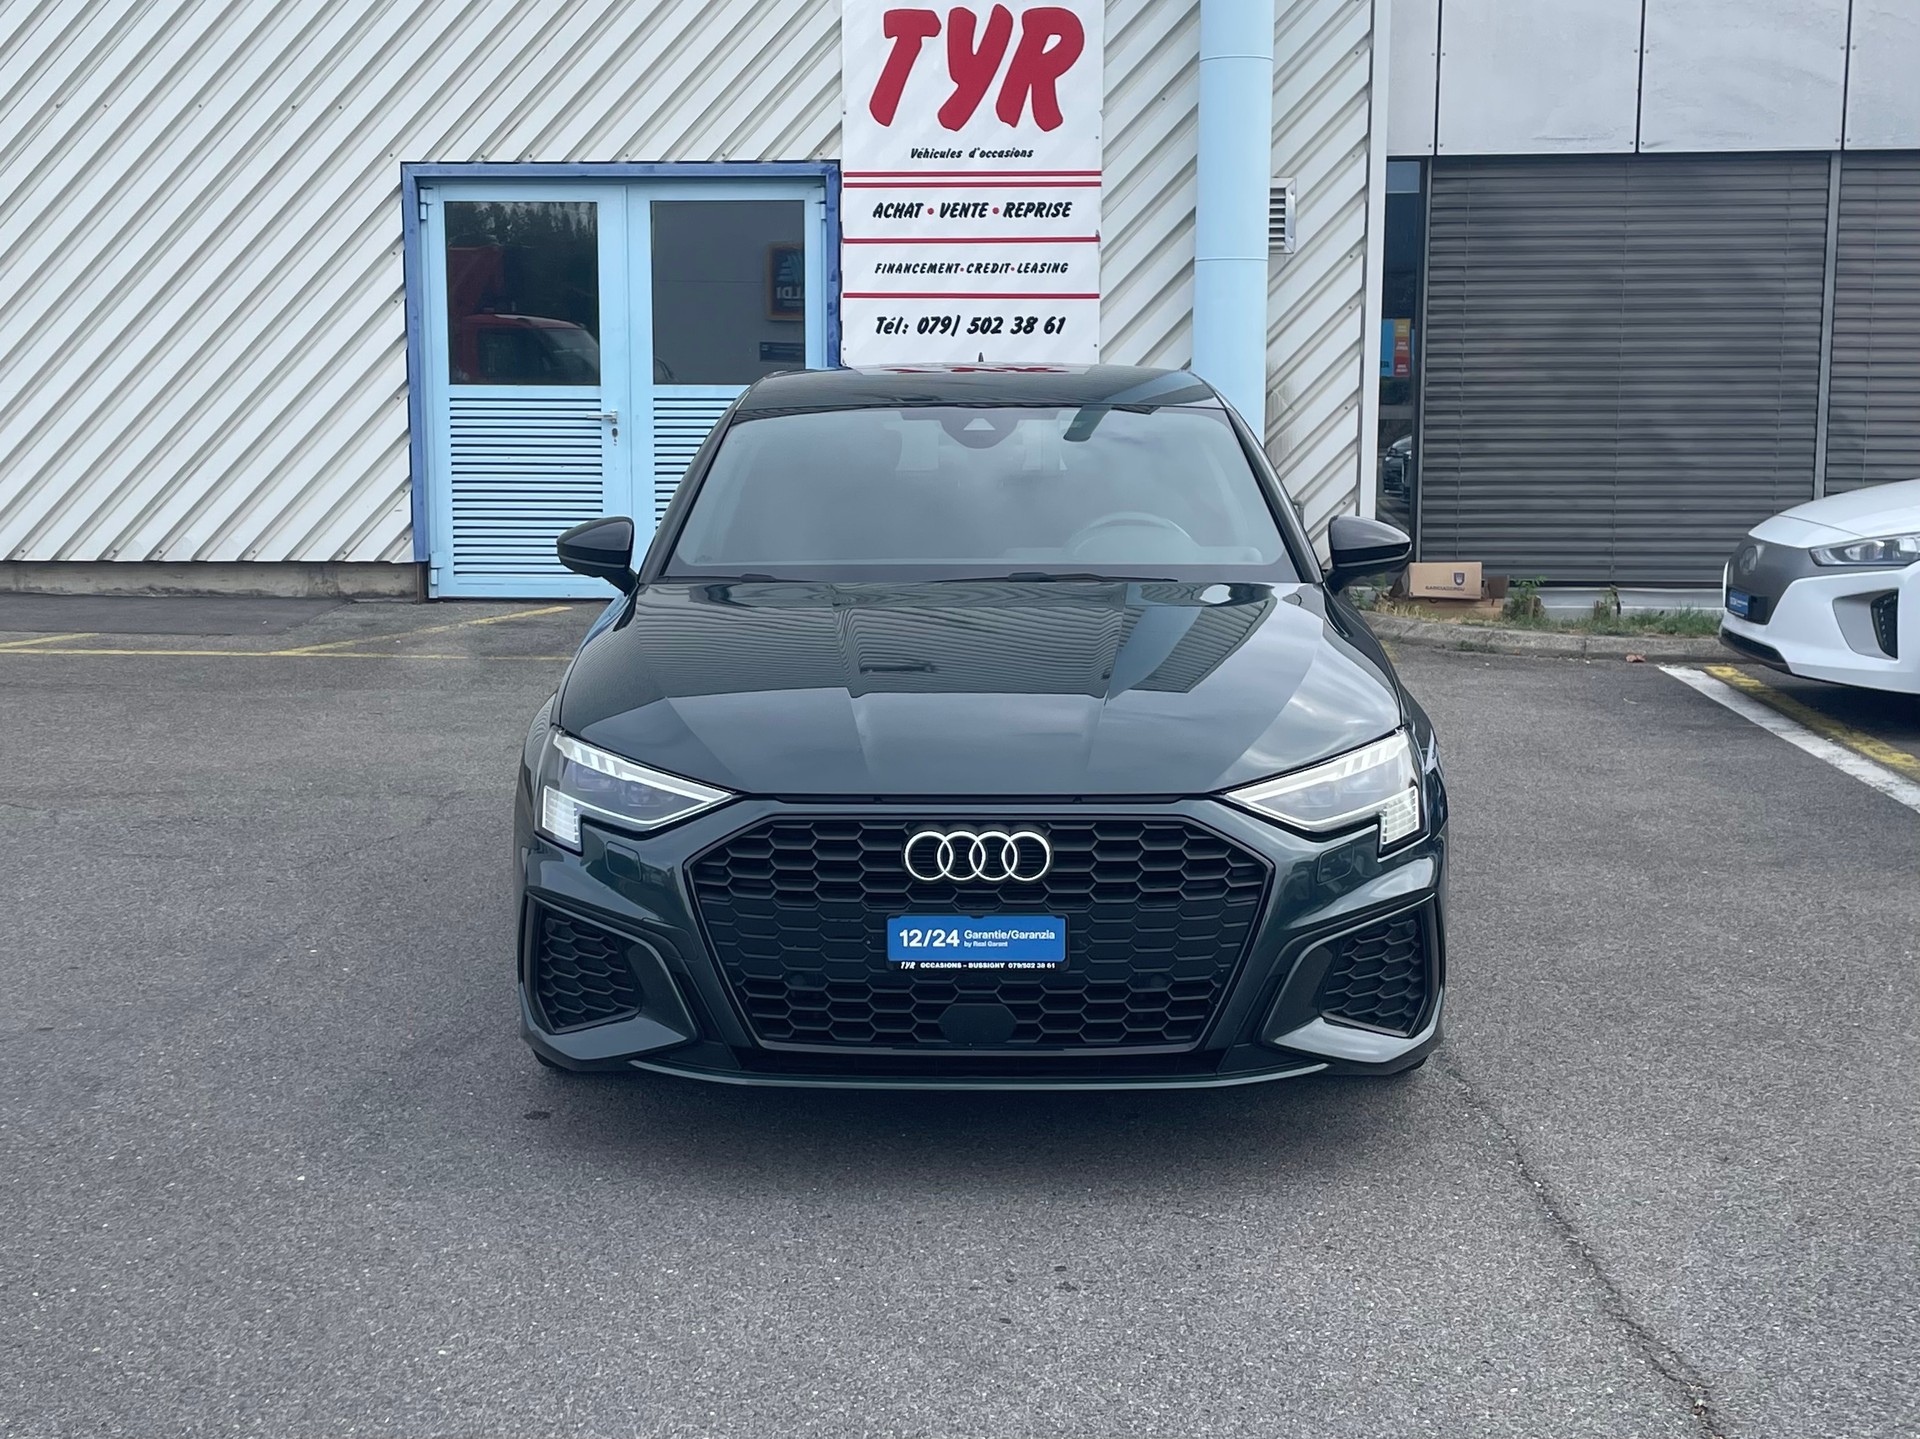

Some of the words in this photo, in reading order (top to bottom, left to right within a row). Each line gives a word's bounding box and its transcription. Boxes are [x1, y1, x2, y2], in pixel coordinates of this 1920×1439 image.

[869, 3, 1085, 132] TYR
[910, 147, 963, 159] Véhicules
[968, 147, 1034, 159] d'occasions
[872, 202, 924, 218] ACHAT
[939, 202, 989, 218] VENTE
[1002, 201, 1073, 218] REPRISE
[874, 262, 961, 274] FINANCEMENT
[966, 262, 1011, 274] CREDIT
[1016, 262, 1069, 274] LEASING
[875, 316, 909, 335] Tél:
[966, 316, 1004, 335] 502
[1010, 316, 1038, 335] 38
[1043, 316, 1066, 335] 61
[899, 929, 960, 948] 12/24
[964, 929, 1056, 940] Garantie/Garanzia
[900, 961, 916, 969] TYR
